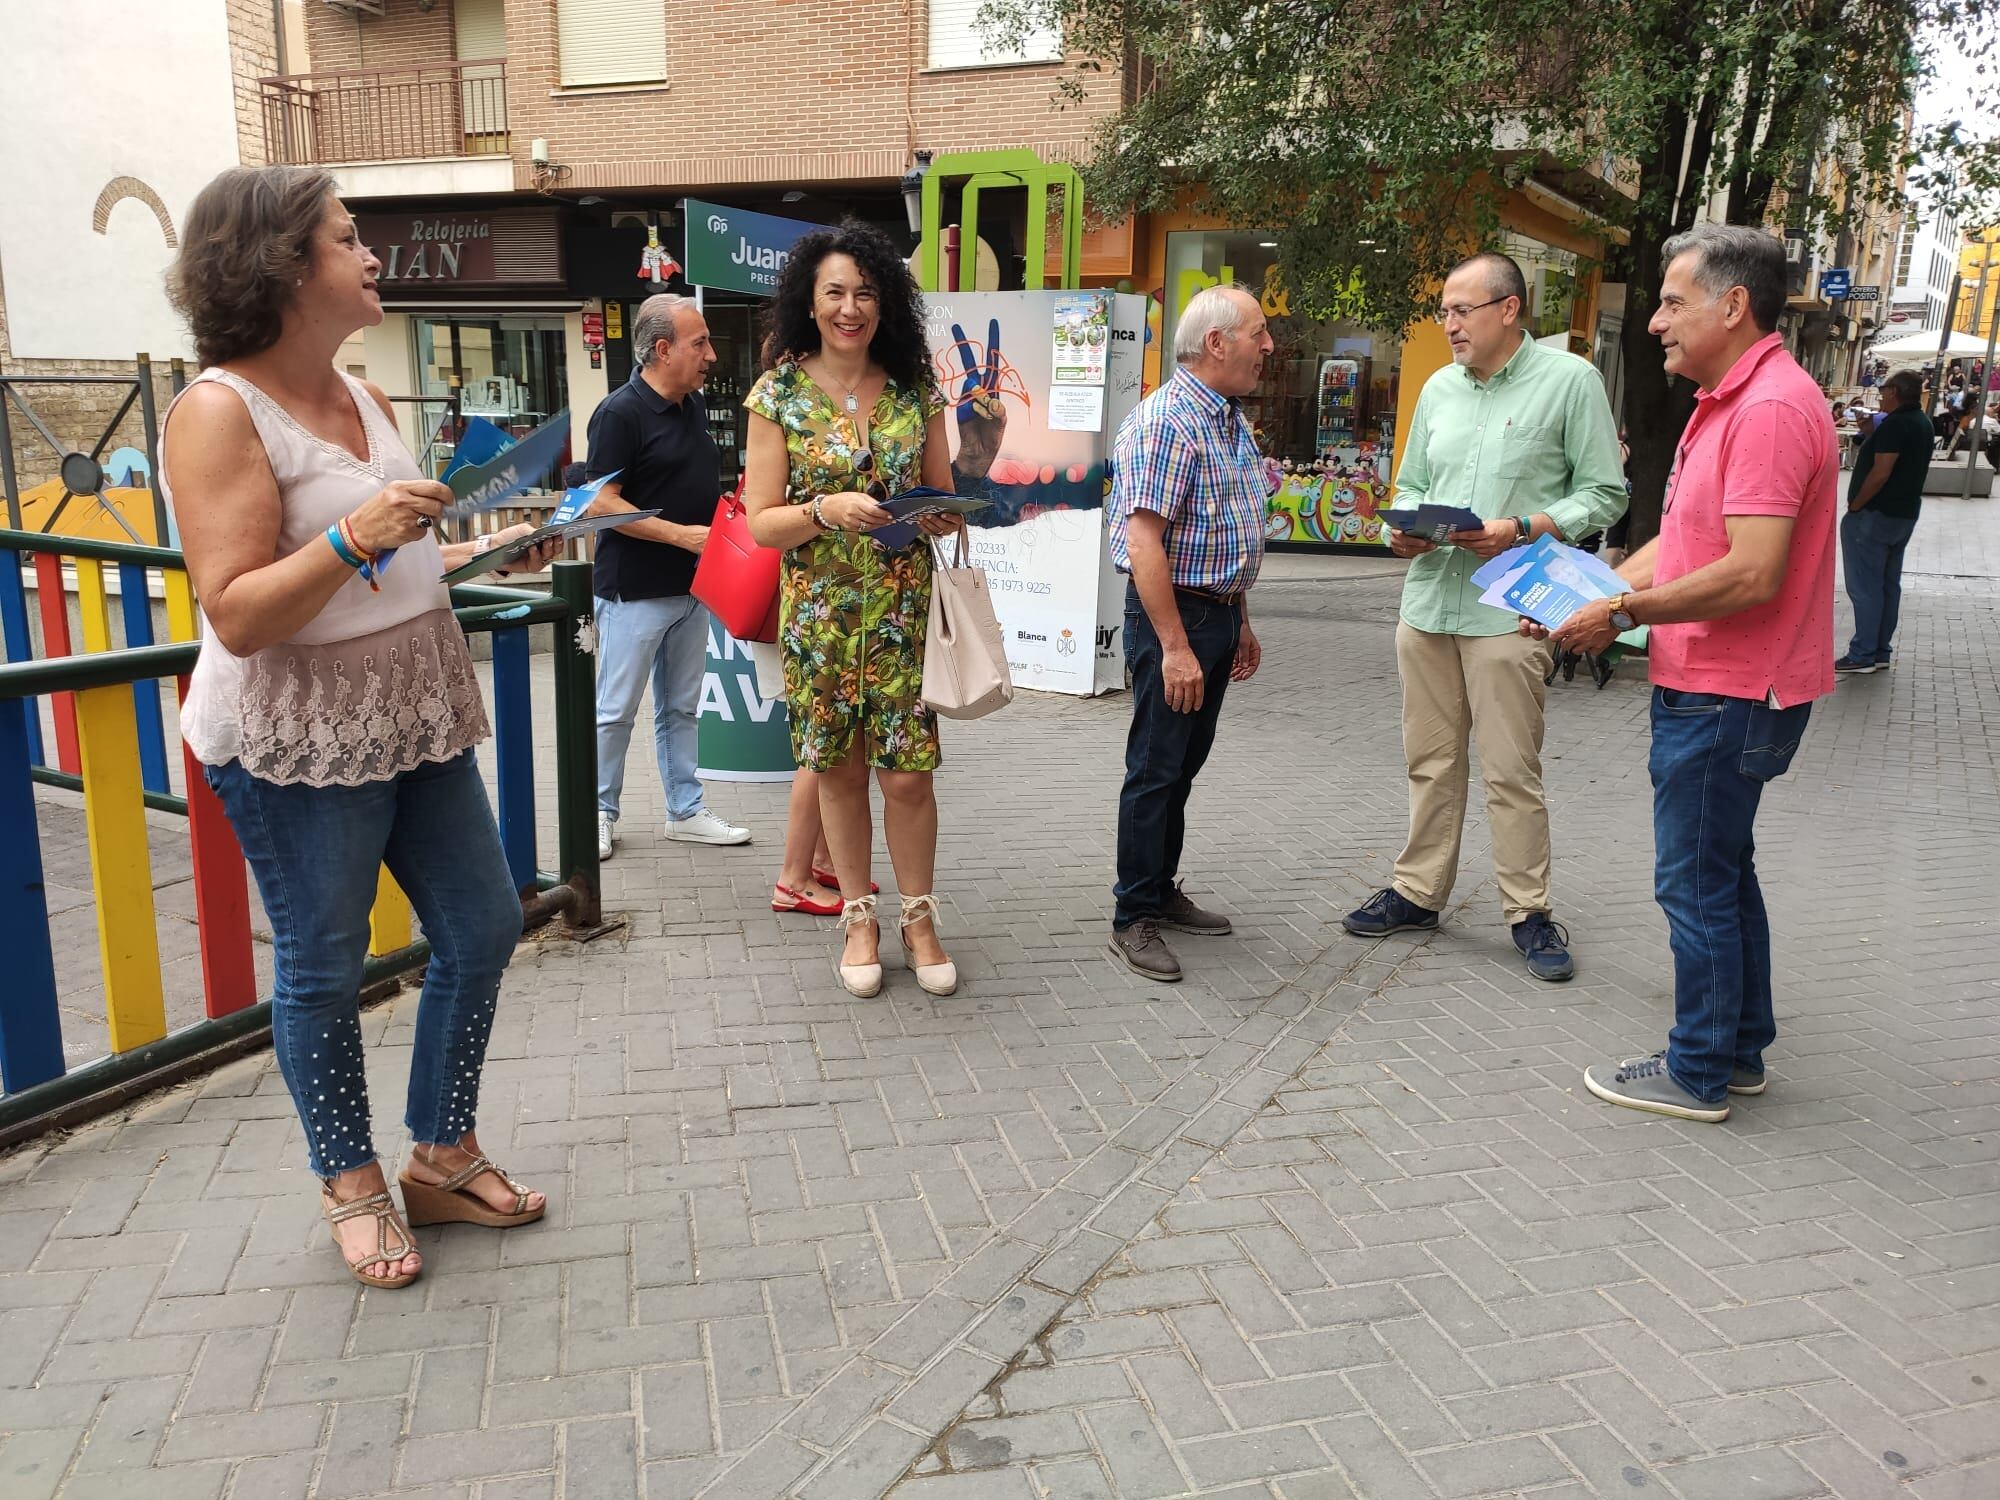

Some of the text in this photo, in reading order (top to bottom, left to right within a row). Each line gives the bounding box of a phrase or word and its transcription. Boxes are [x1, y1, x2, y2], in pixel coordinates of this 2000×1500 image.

[411, 218, 489, 242] Relojeria
[976, 542, 1006, 555] 02333
[1001, 579, 1023, 592] 1973
[1026, 581, 1052, 594] 9225
[1017, 631, 1047, 641] Blanca
[697, 672, 790, 722] AV
